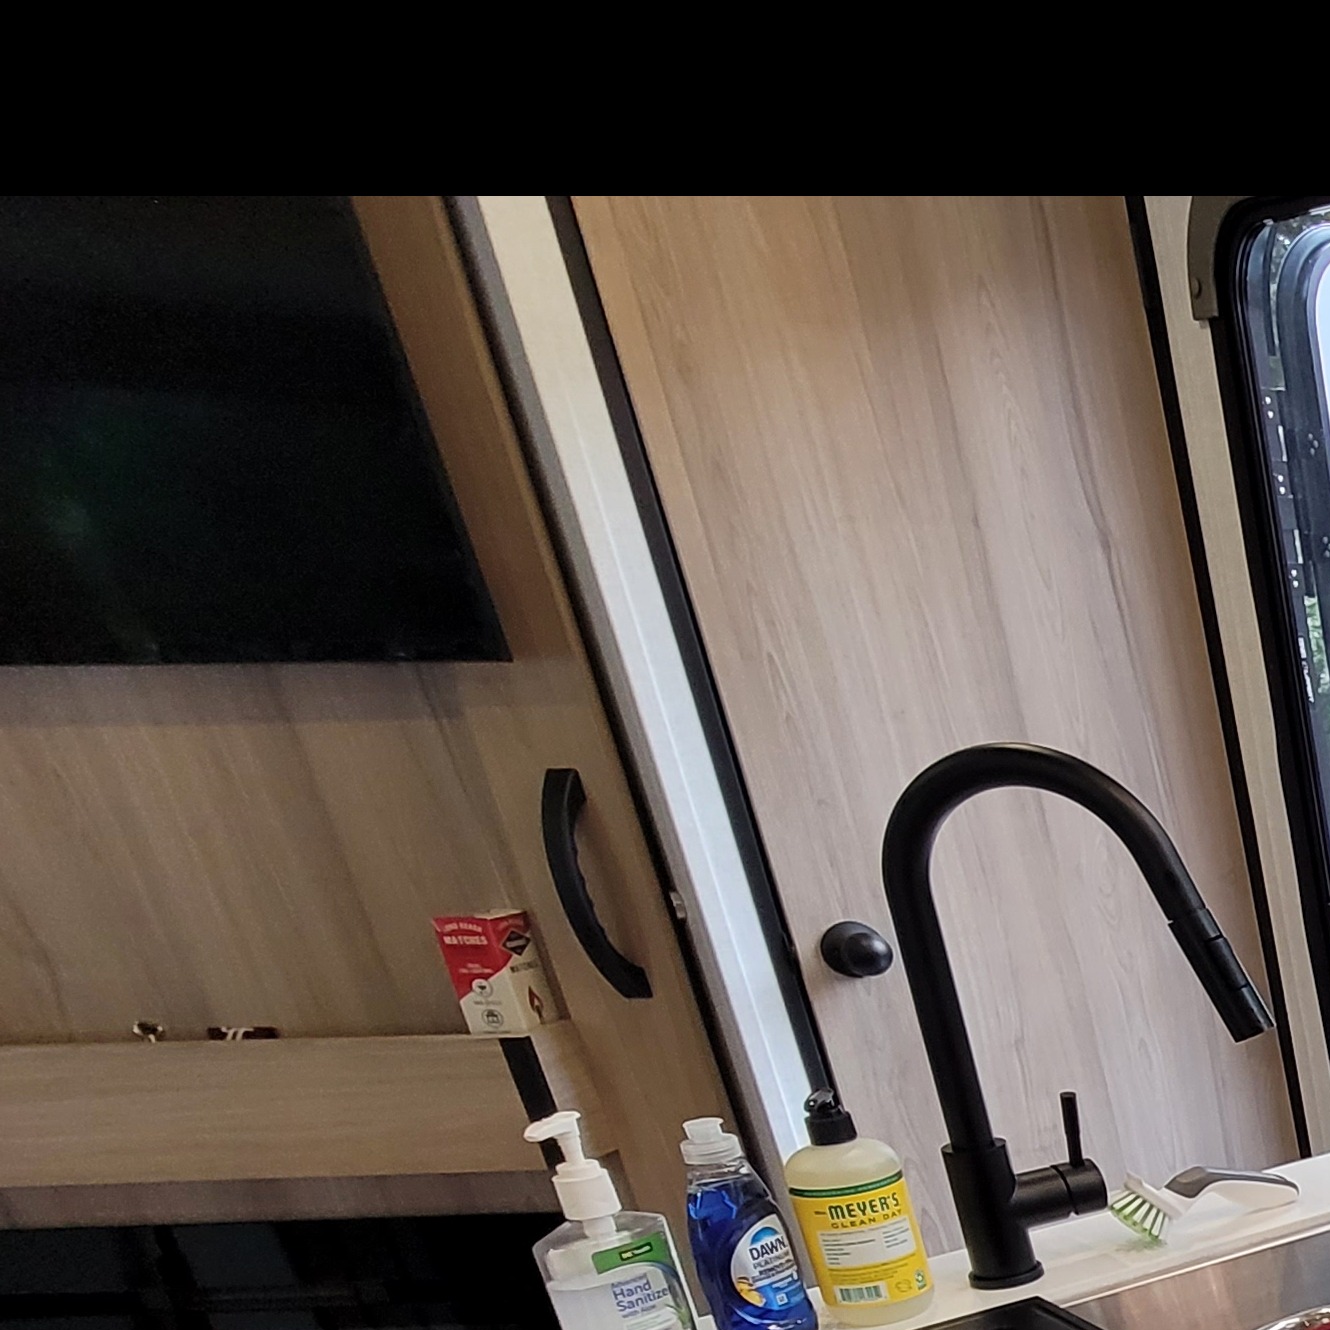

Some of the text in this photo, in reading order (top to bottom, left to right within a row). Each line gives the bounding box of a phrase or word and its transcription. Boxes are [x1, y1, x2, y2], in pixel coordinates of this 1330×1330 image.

[827, 1191, 900, 1221] MEYER'S
[830, 1208, 903, 1229] CLEAN DAY
[748, 1235, 787, 1261] DAWN
[613, 1278, 652, 1301] Hand
